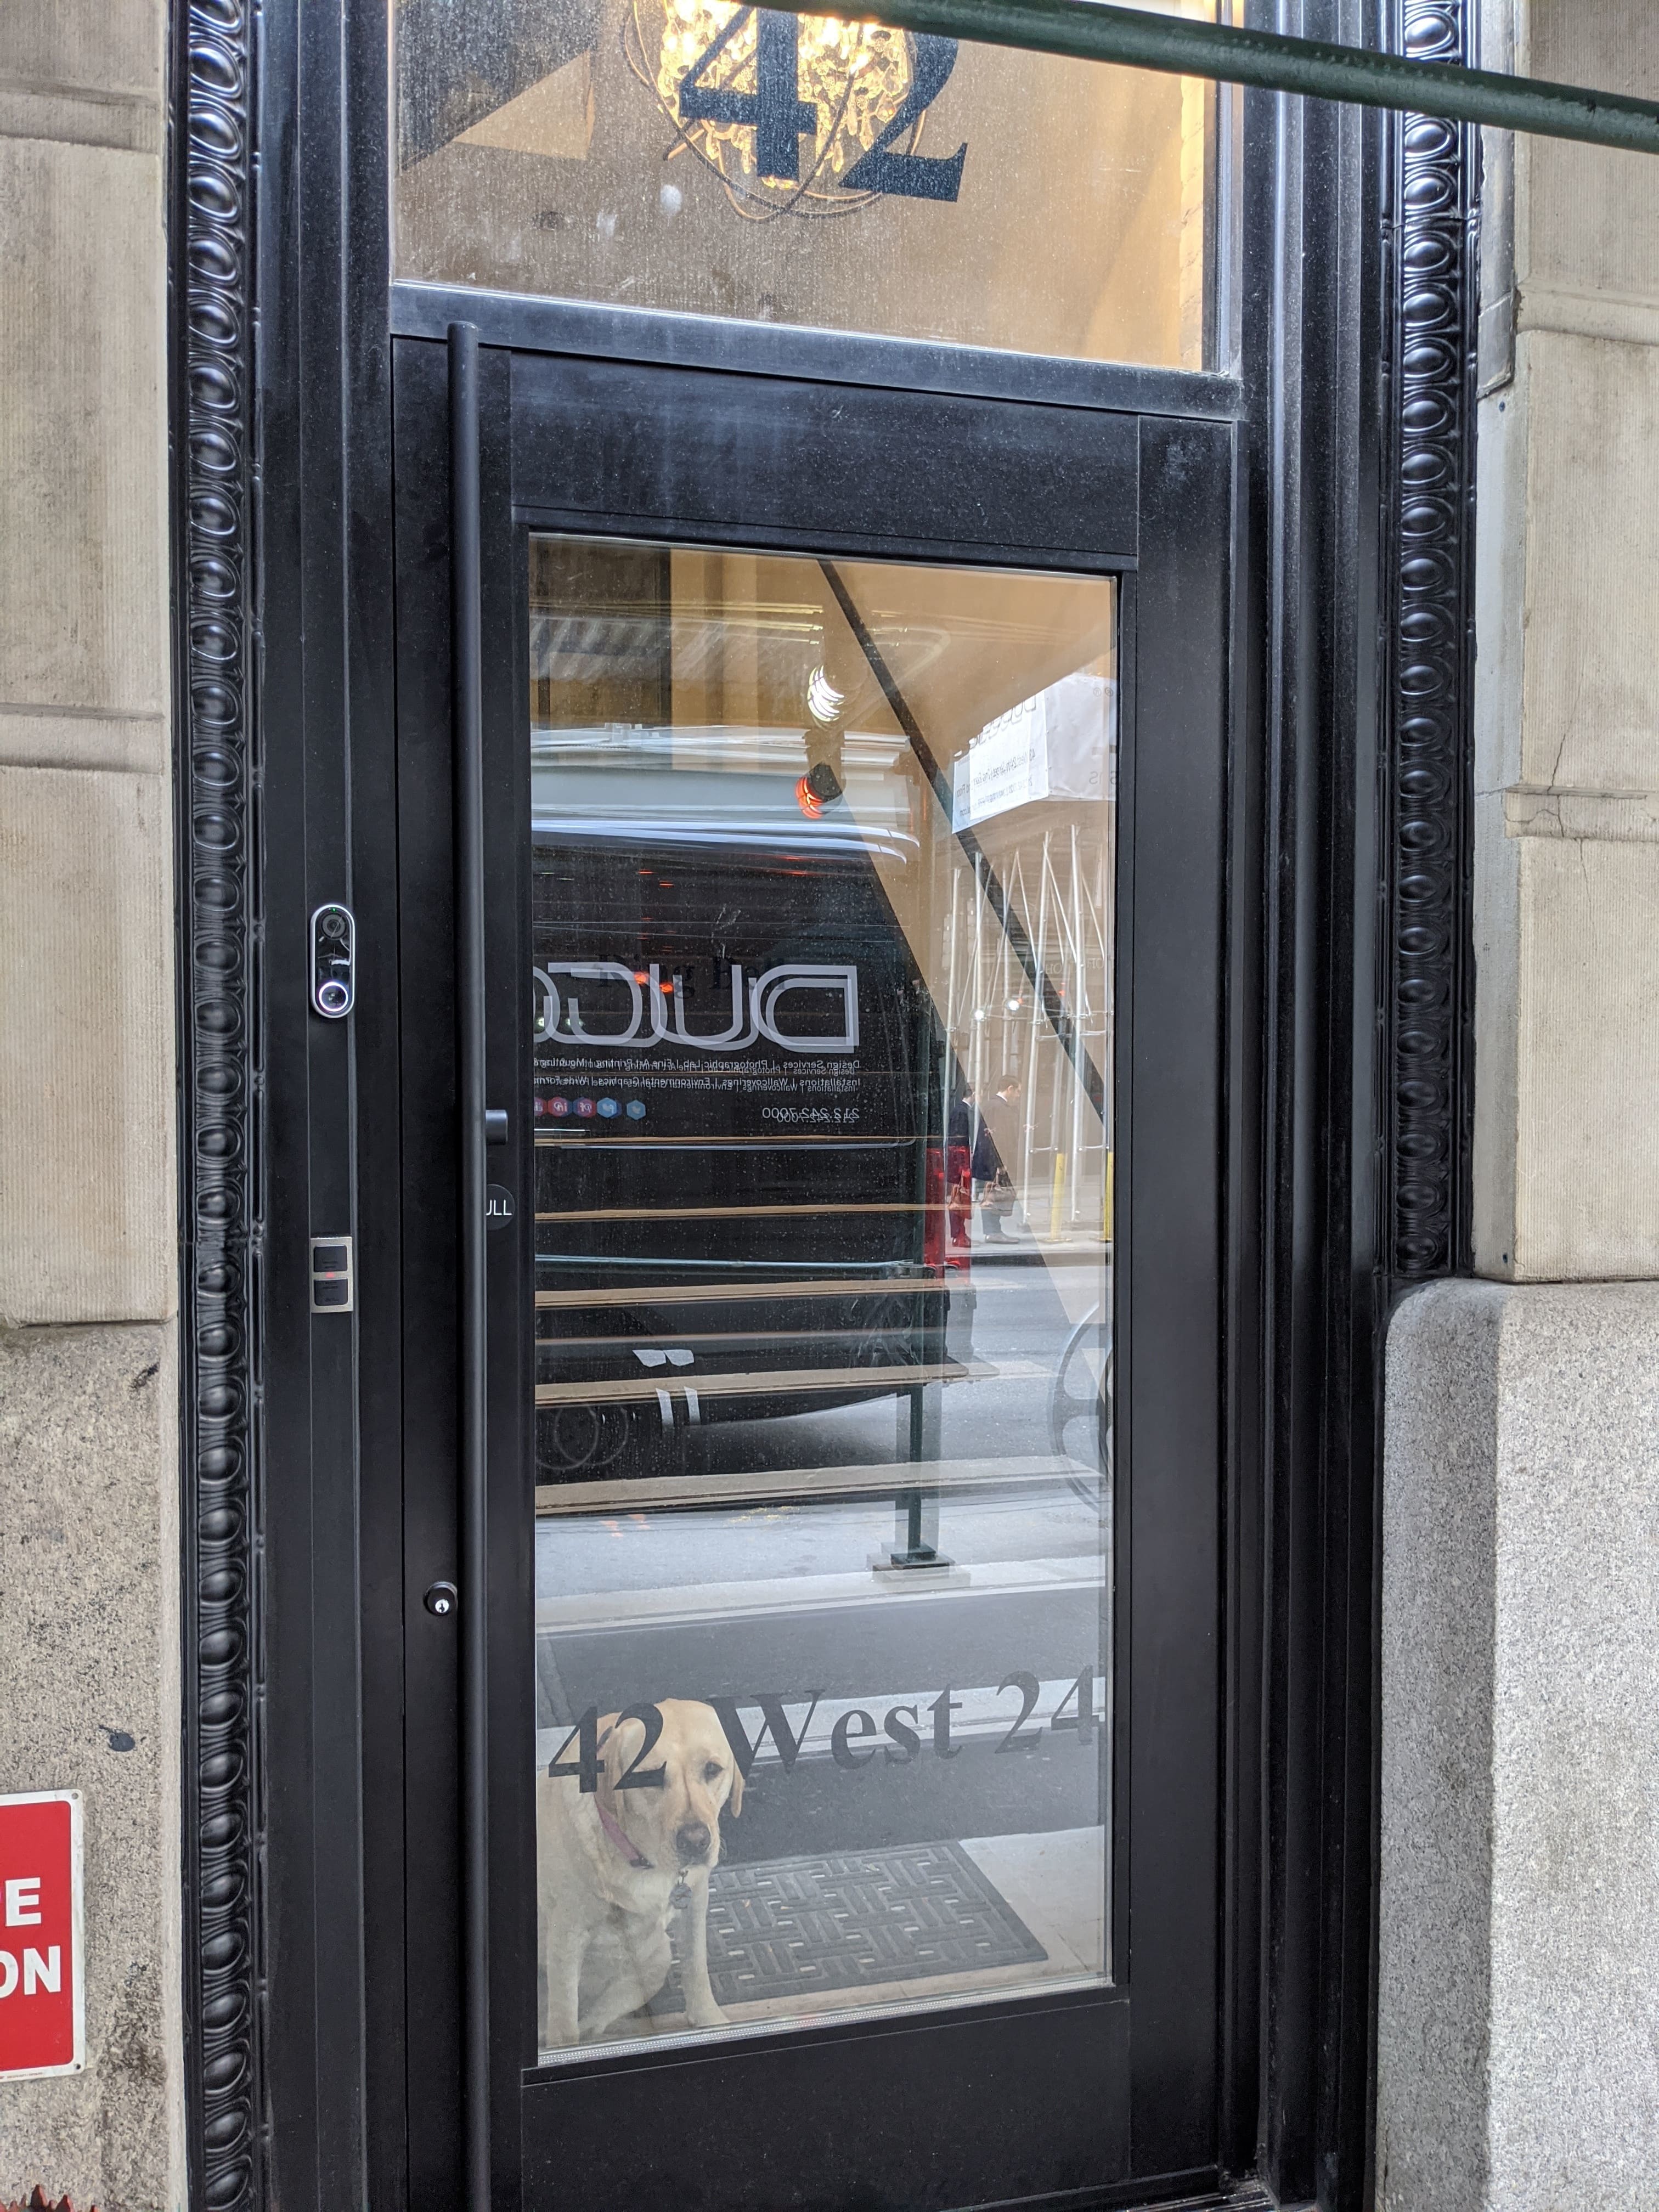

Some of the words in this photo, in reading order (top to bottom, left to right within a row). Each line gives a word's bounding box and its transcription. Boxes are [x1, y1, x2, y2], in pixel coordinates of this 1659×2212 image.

[679, 6, 968, 202] 42
[548, 1702, 667, 1793] 42
[706, 1684, 963, 1780] West
[994, 1665, 1099, 1754] 24
